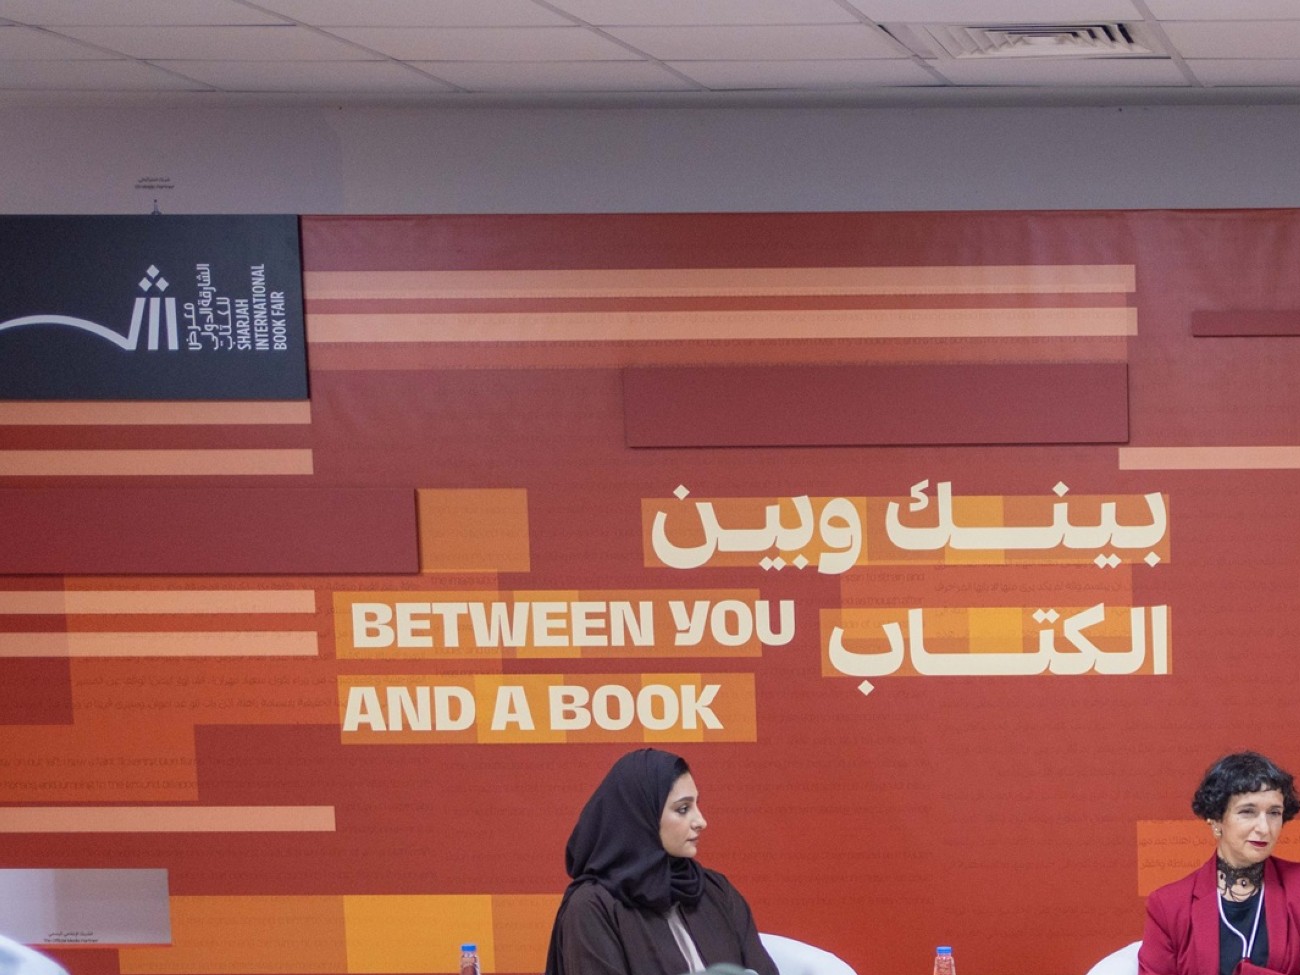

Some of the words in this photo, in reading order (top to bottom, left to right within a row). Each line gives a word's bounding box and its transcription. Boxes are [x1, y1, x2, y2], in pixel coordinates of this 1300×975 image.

[196, 263, 216, 307] الشارقة
[250, 263, 269, 351] INTERNATIONAL
[270, 291, 285, 316] FAIR
[184, 302, 202, 351] معرض
[235, 299, 251, 351] SHARJAH
[272, 319, 287, 351] BOOK
[651, 484, 863, 575] وبين
[885, 479, 1168, 568] بينك
[351, 601, 654, 648] BETWEEN
[669, 600, 796, 646] YOU
[828, 602, 1168, 696] الكتاب
[342, 686, 476, 731] AND
[490, 685, 535, 731] A
[548, 684, 724, 730] BOOK
